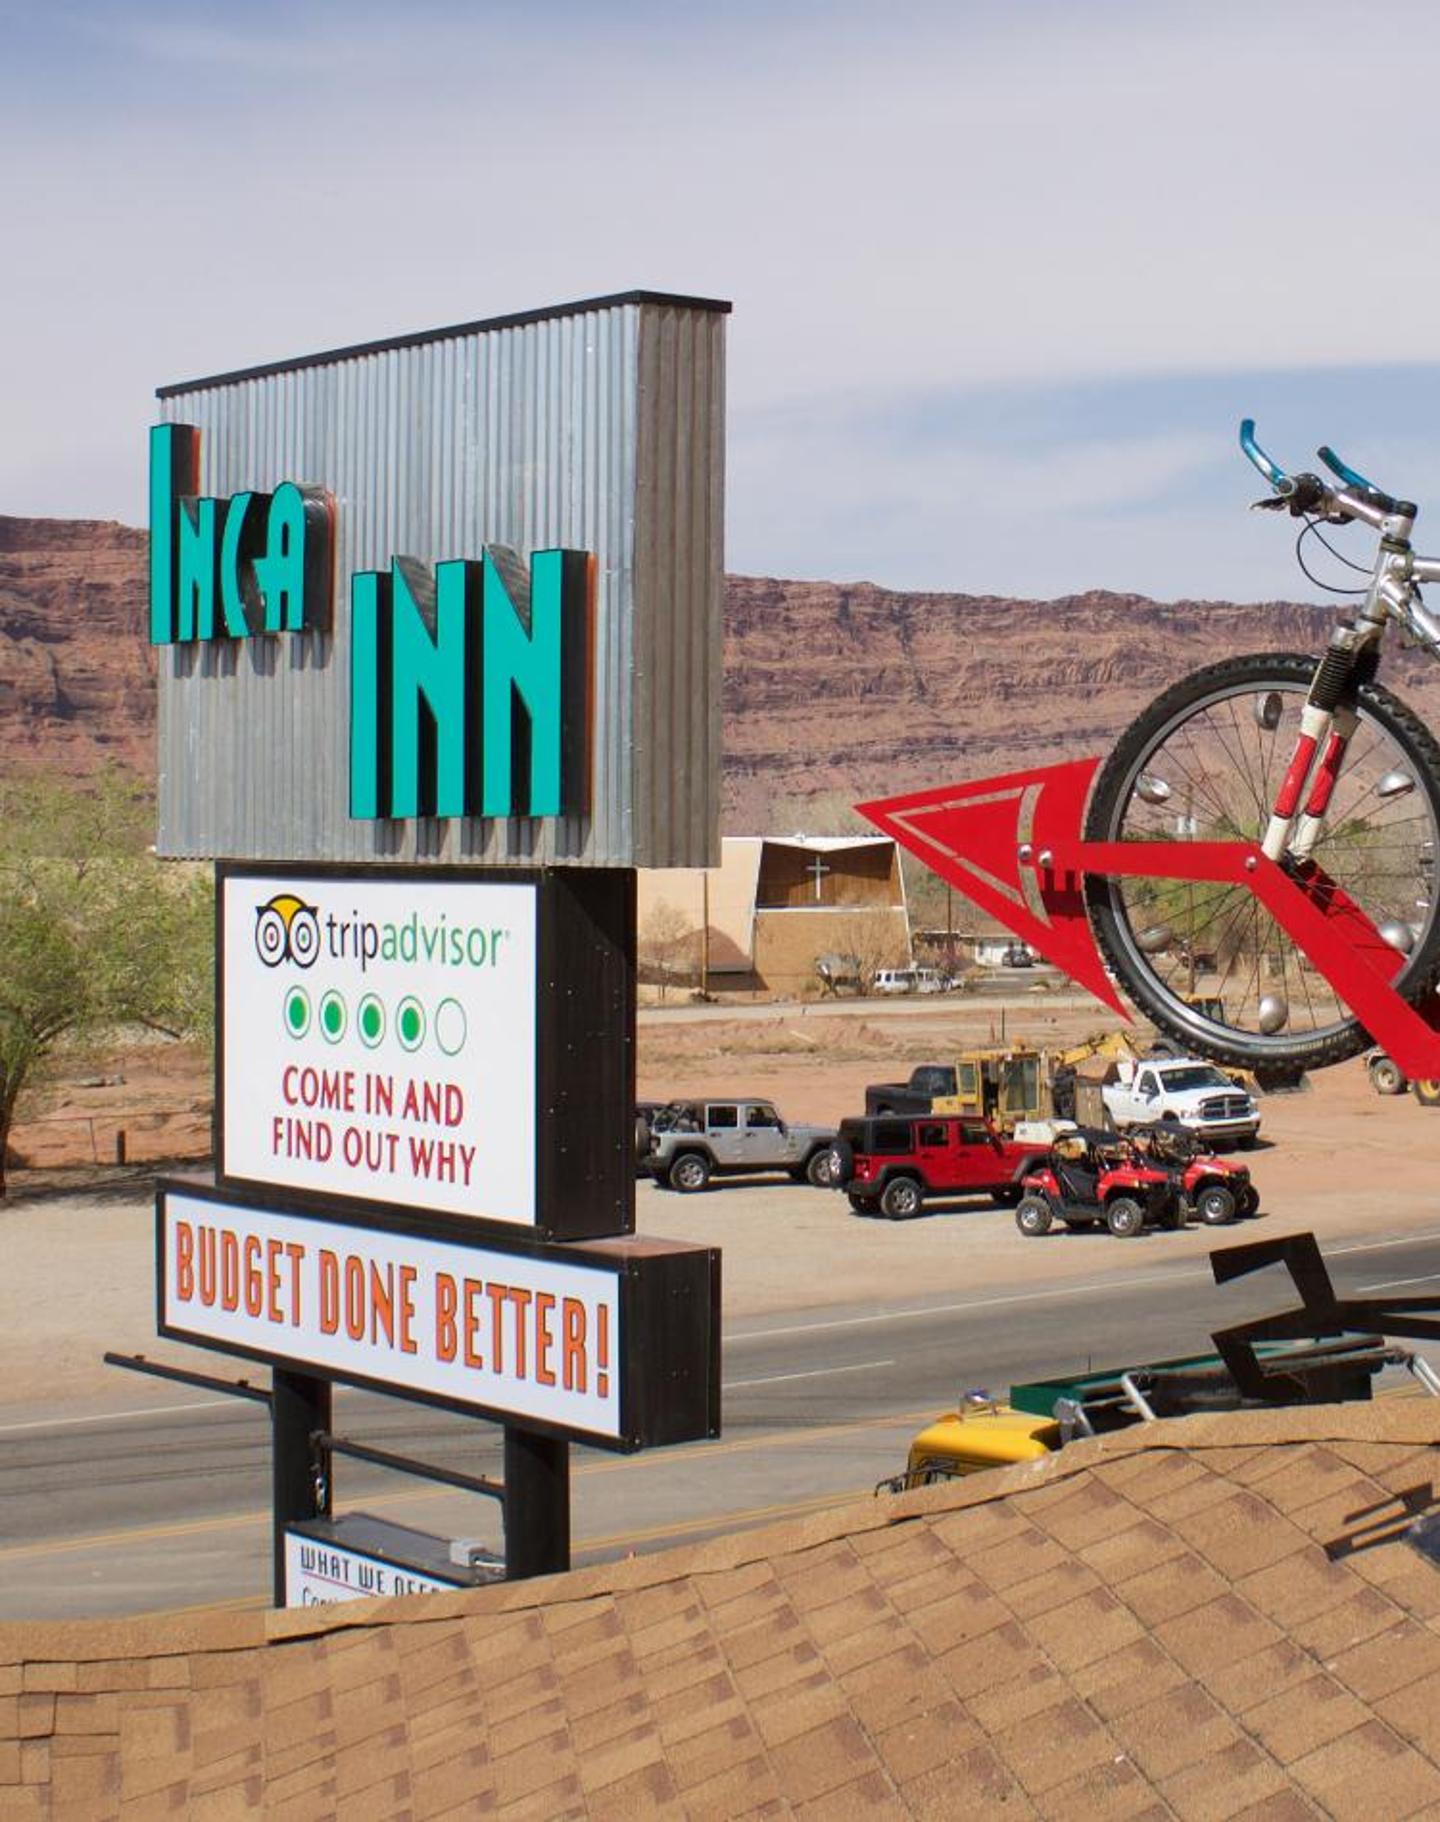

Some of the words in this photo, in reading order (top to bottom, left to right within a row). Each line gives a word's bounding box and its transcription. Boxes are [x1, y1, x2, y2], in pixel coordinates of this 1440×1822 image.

[149, 424, 308, 645] INCA
[351, 545, 563, 819] INN
[326, 909, 503, 973] tripadvisor
[282, 1065, 355, 1114] COME
[366, 1073, 394, 1118] IN
[402, 1078, 465, 1128] AND
[272, 1117, 333, 1163] FIND
[342, 1126, 401, 1174] OUT
[409, 1137, 477, 1186] WHY
[175, 1219, 306, 1328] BUDGET
[318, 1248, 419, 1355] DONE
[434, 1270, 609, 1399] BETTER!
[300, 1544, 351, 1583] WHAT
[358, 1563, 386, 1595] WE
